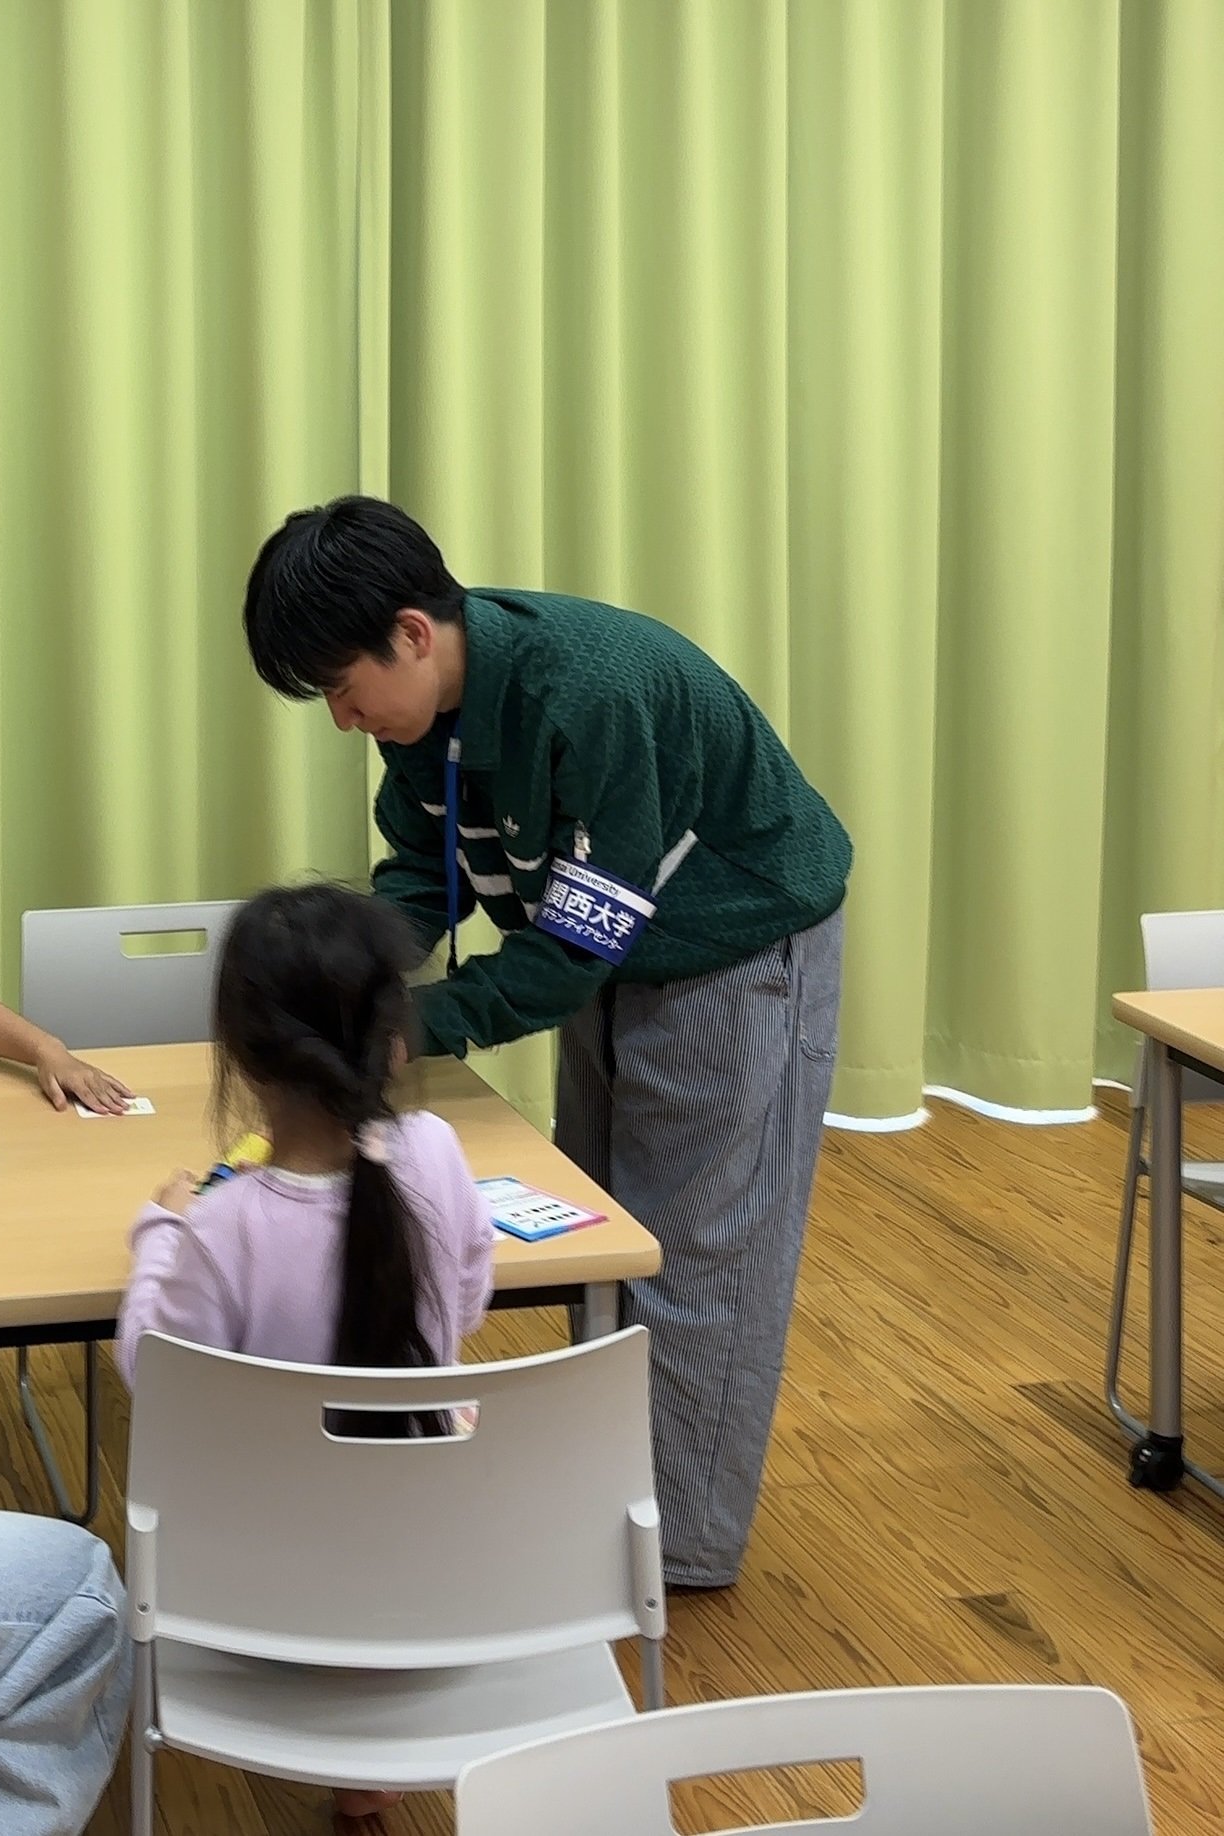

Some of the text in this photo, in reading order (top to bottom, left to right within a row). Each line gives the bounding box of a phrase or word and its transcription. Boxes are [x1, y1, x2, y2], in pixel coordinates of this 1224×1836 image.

[569, 865, 621, 897] University
[543, 879, 636, 938] 関西大学
